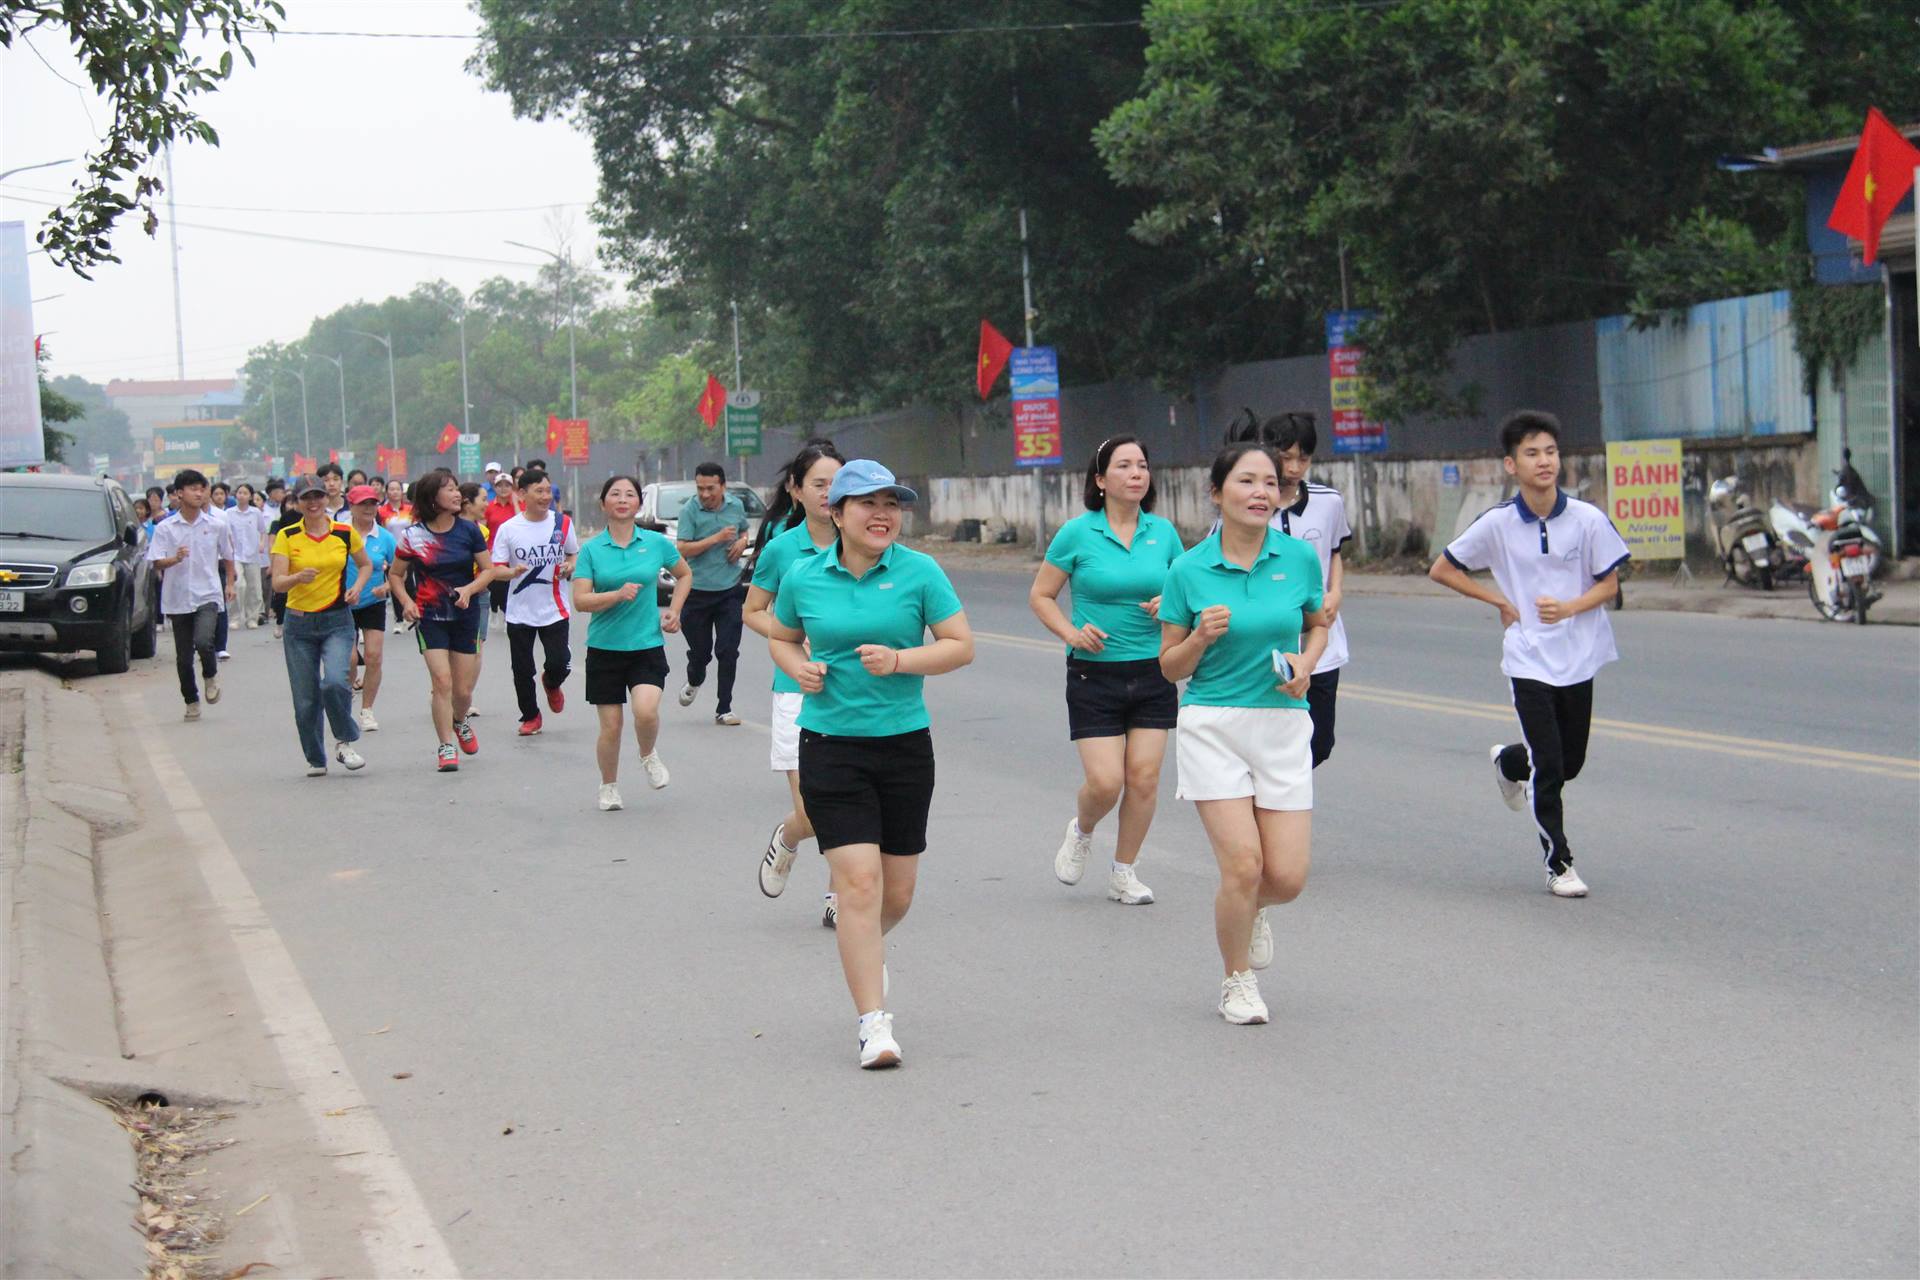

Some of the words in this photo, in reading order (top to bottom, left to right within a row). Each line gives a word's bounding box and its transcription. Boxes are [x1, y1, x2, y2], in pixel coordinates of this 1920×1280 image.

[1614, 460, 1678, 486] BÁNH
[1615, 490, 1680, 520] CUỐN
[515, 544, 564, 561] QATAR
